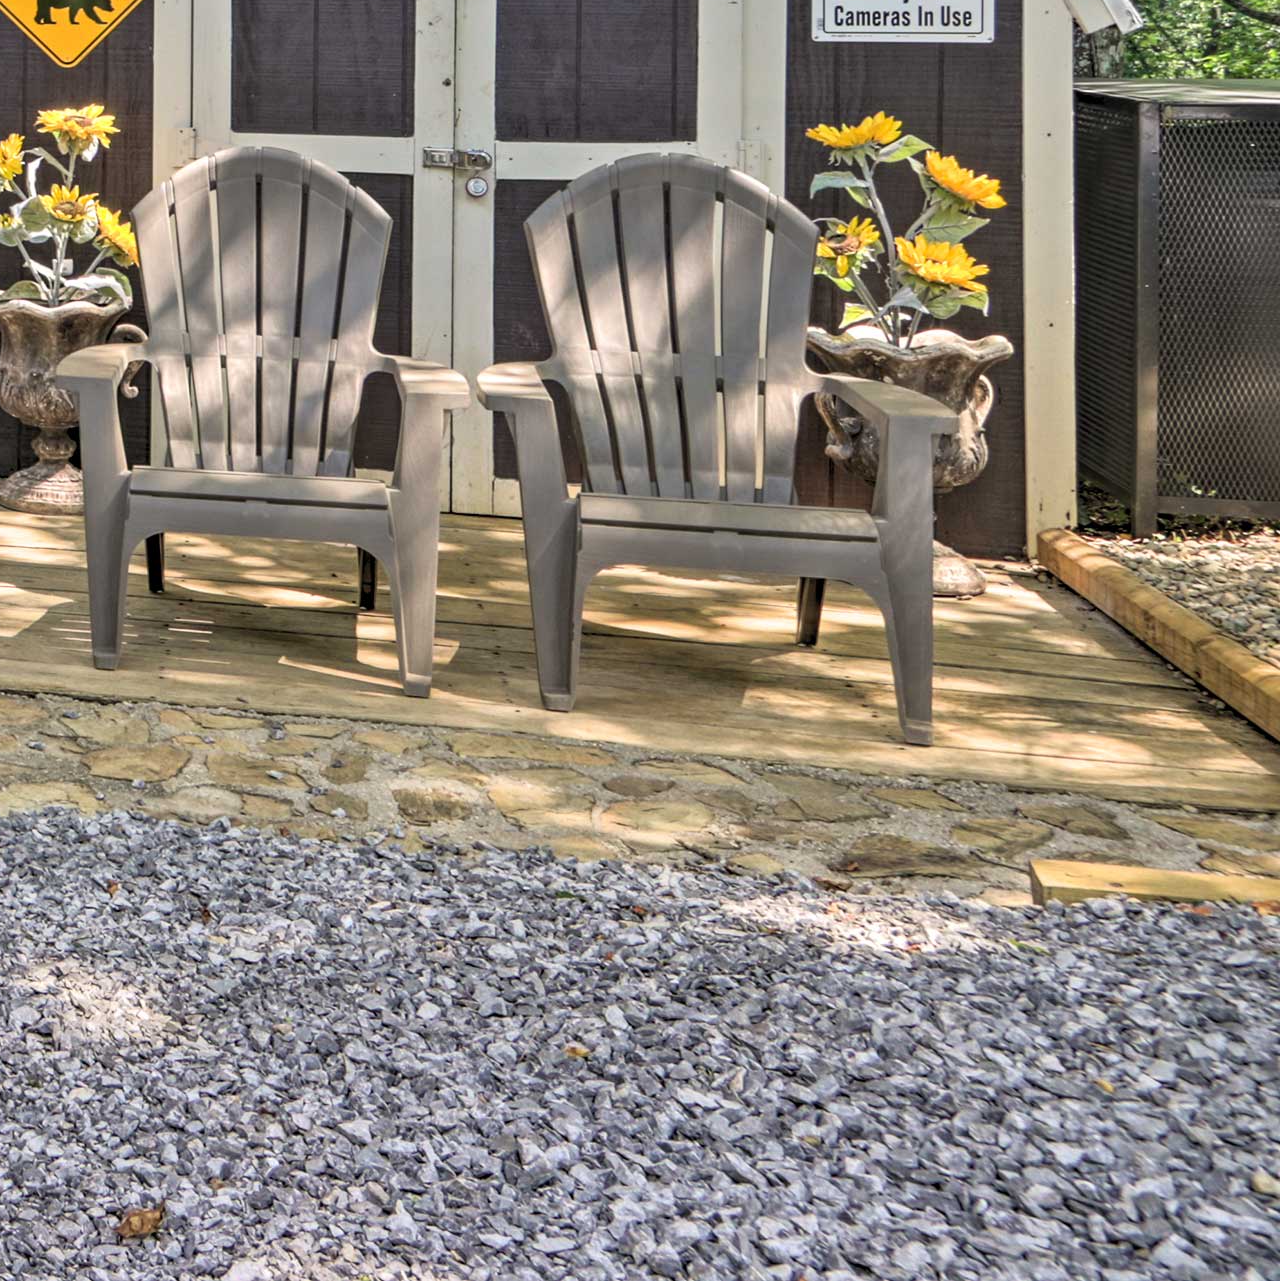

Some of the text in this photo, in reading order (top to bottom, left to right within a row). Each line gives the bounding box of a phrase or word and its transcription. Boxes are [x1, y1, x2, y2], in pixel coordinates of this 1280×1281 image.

[834, 6, 910, 26] Cameras
[918, 6, 934, 26] In
[941, 6, 972, 26] Use
